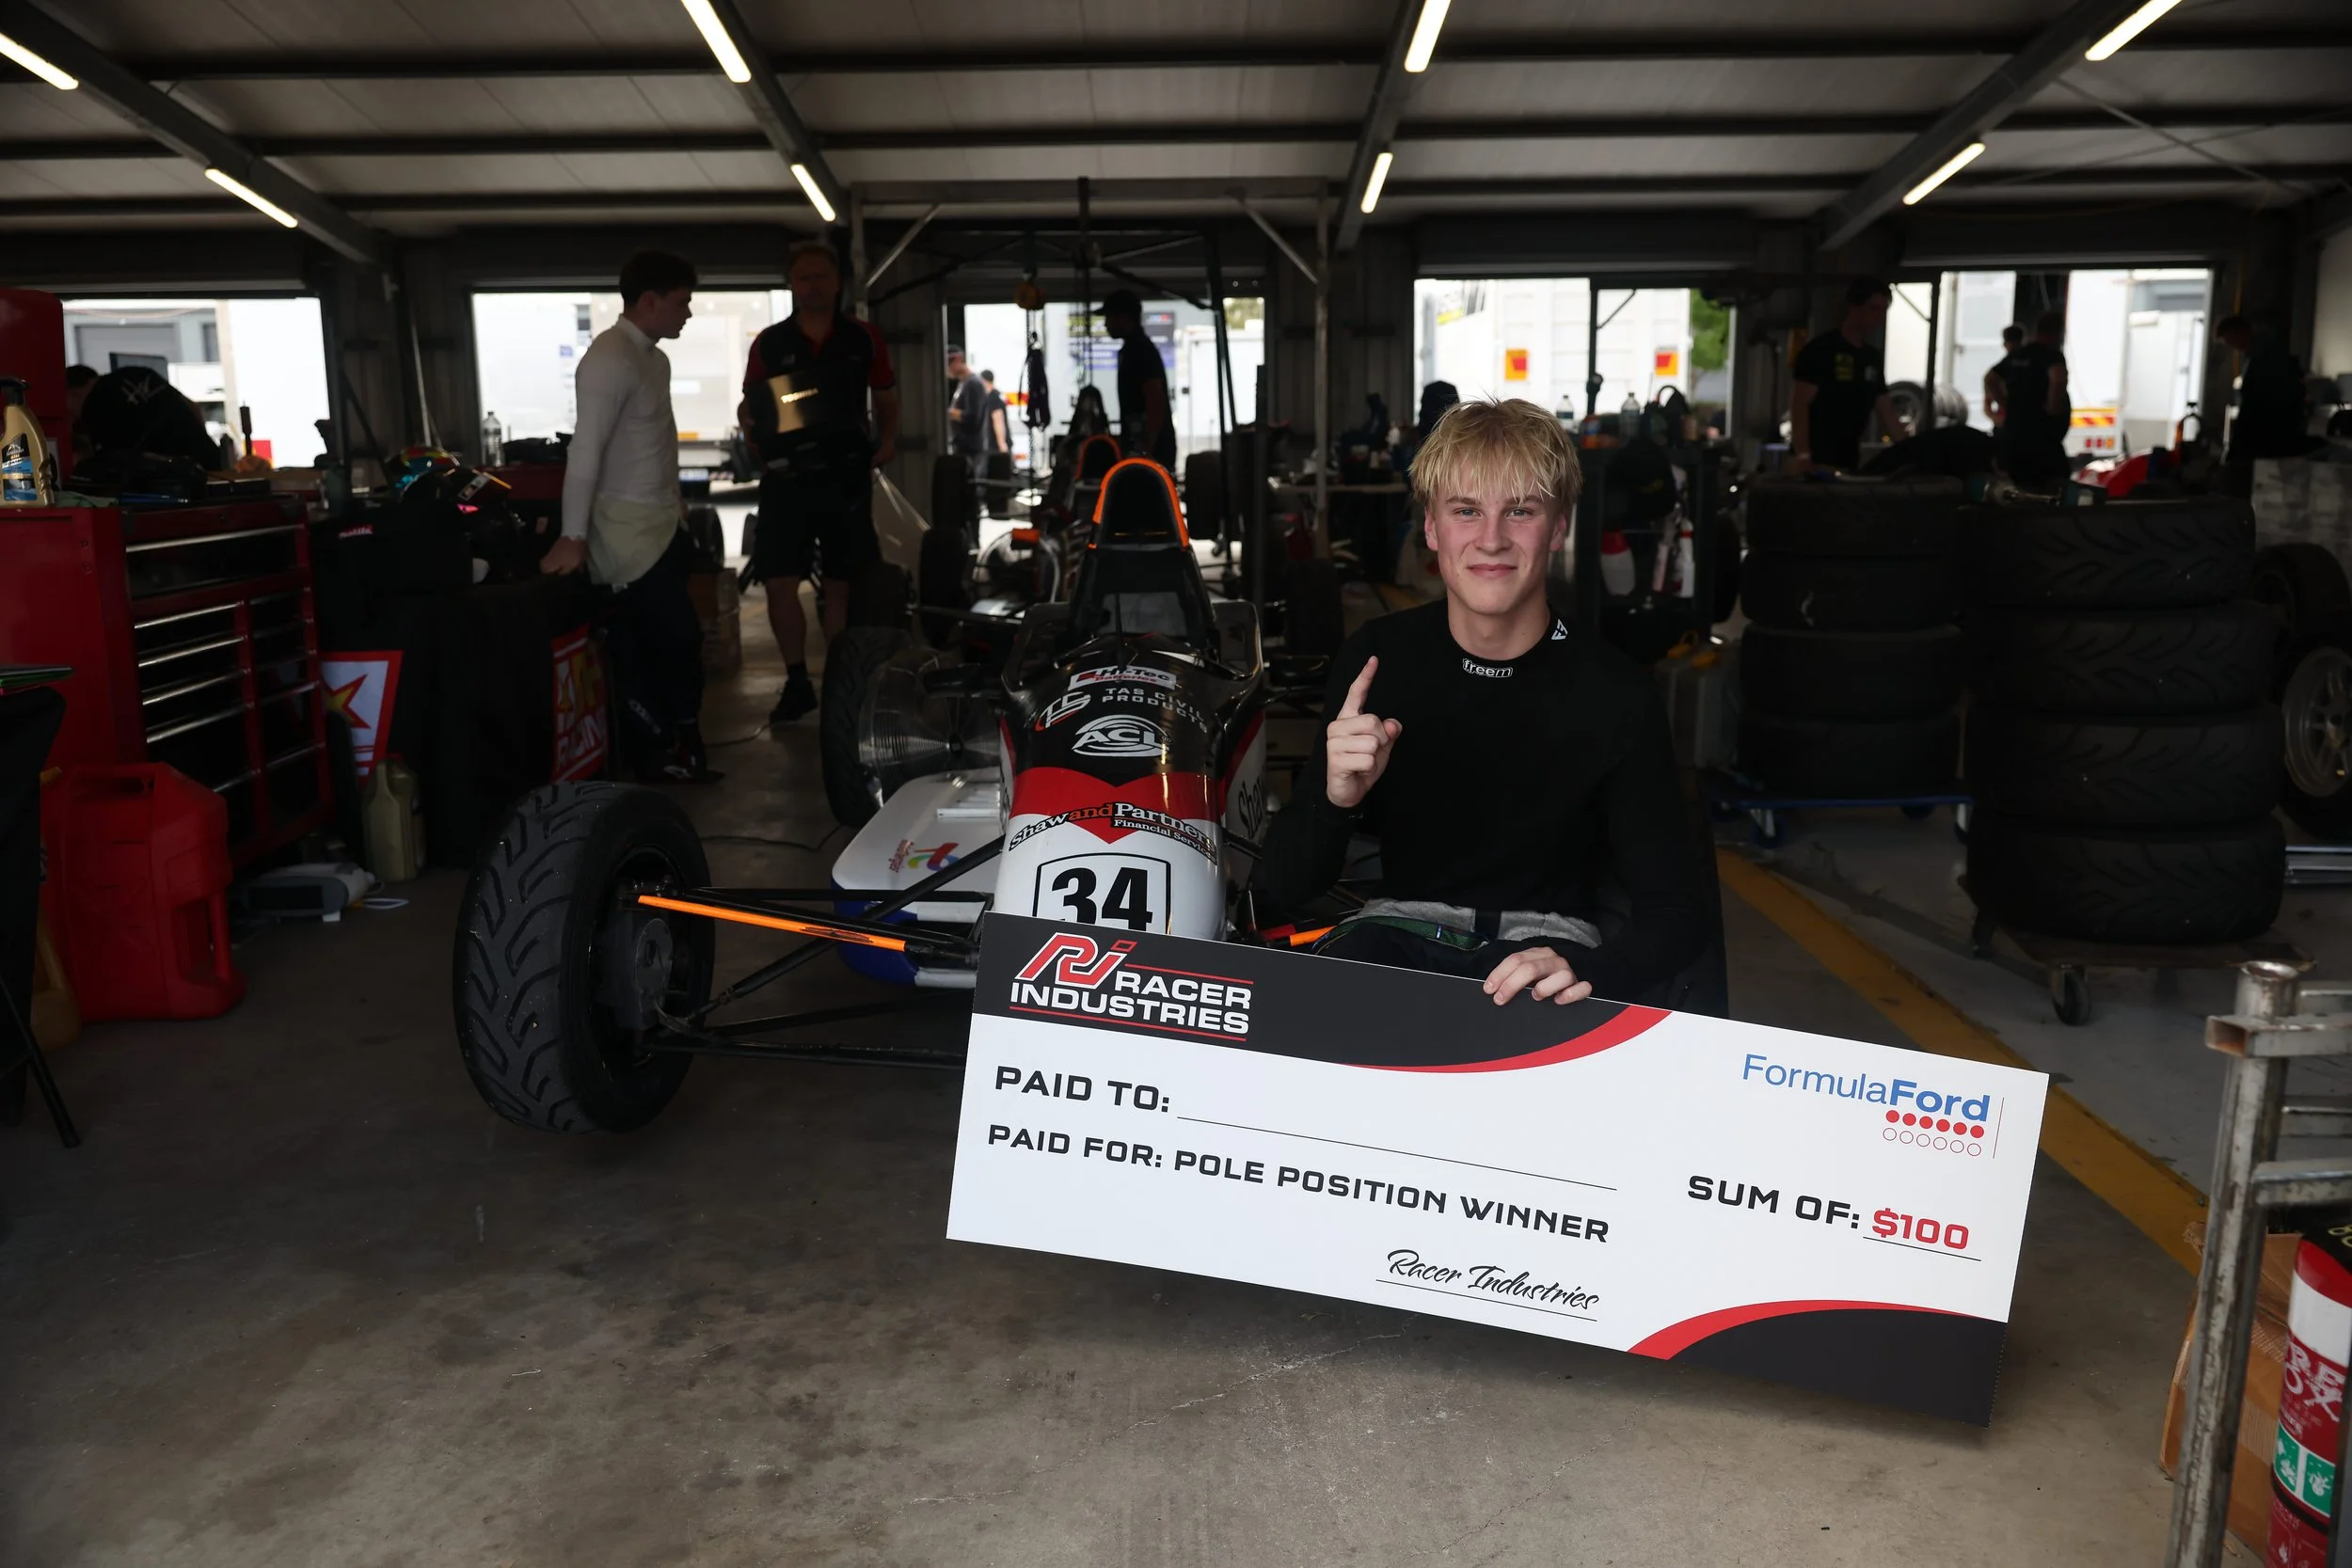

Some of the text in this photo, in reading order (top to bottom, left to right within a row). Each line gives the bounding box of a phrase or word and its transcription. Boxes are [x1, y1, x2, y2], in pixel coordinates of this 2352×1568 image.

[1462, 657, 1514, 677] freem
[1102, 695, 1208, 734] PRODUCTS
[1154, 691, 1204, 722] CIVIL
[1072, 726, 1170, 752] ACL
[1114, 819, 1170, 836] Financial
[1052, 866, 1153, 931] 34
[1010, 981, 1249, 1035] INDUSTRIES
[1114, 970, 1252, 1010] RACER
[994, 1065, 1170, 1114] PAID TO:
[1742, 1053, 1991, 1122] FormulaFord
[988, 1124, 1610, 1243] PAID FOR: POLE POSITION WINNER
[1687, 1175, 1970, 1251] SUM OF: $100
[1387, 1248, 1600, 1310] Racer Industries
